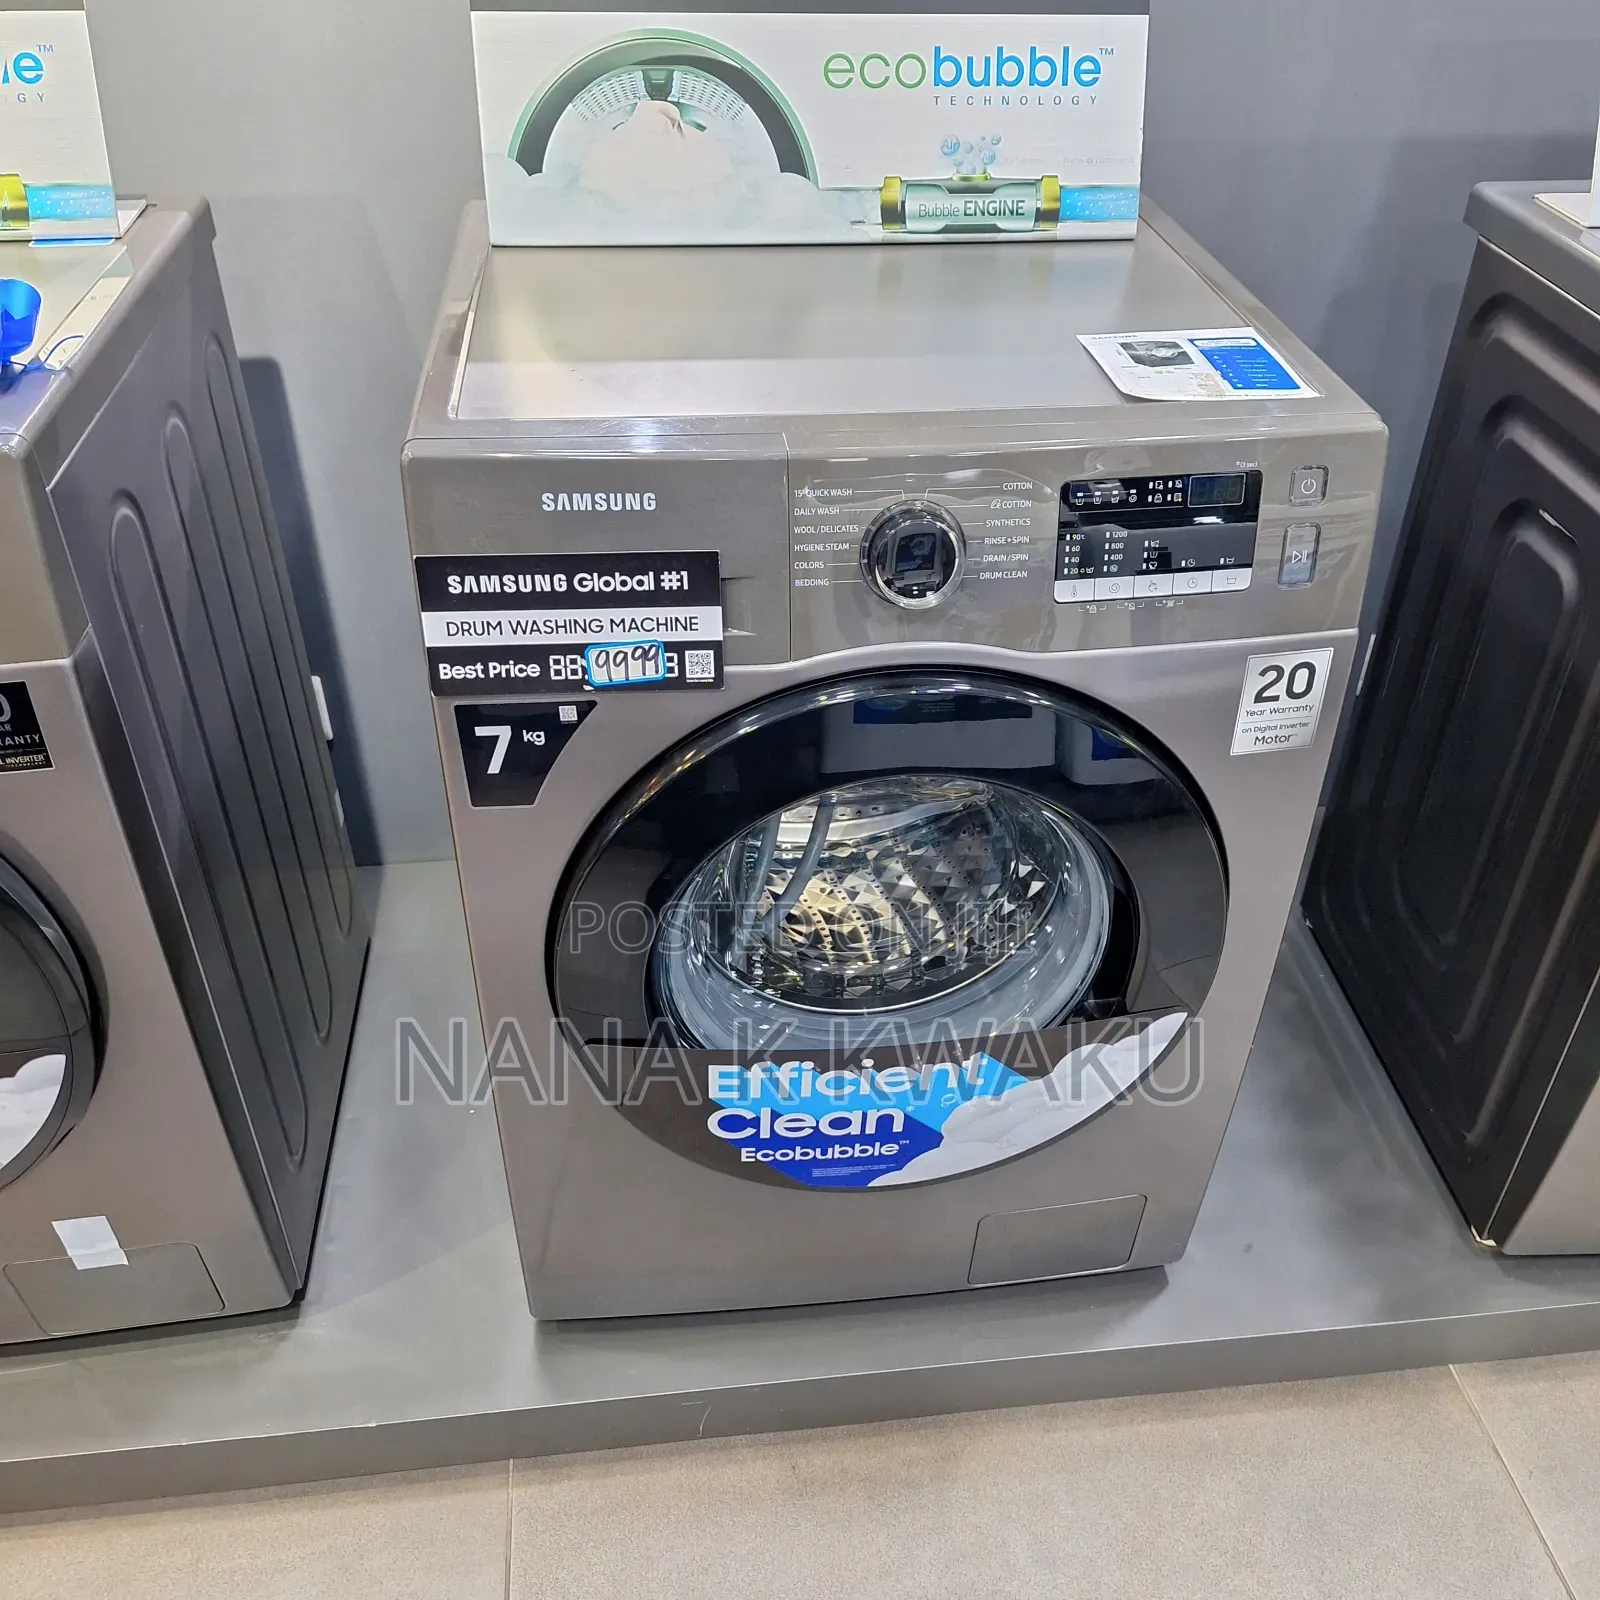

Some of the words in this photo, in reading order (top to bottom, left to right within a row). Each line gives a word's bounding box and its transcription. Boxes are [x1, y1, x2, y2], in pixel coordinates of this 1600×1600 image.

[933, 95, 1098, 106] TECHNOLOGY
[918, 203, 960, 218] Bubble
[963, 199, 1026, 217] ENGINE
[1002, 482, 1033, 491] COTTON
[805, 488, 830, 498] QUICK
[830, 488, 853, 497] WASH
[541, 492, 657, 512] SAMSUNG
[1002, 500, 1032, 509] COTTON
[794, 508, 817, 516] DAILY
[817, 507, 840, 516] WASH
[985, 518, 1031, 528] SYNTHETICS
[1112, 530, 1128, 538] 1200
[794, 543, 825, 552] HYGIENE
[825, 542, 850, 551] STEAM
[1111, 542, 1125, 550] 800
[1070, 556, 1080, 564] 40
[1110, 553, 1124, 561] 400
[794, 560, 825, 569] COLORS
[979, 571, 1002, 580] DRUM
[1002, 570, 1028, 579] CLEAN
[1069, 567, 1079, 575] 20
[447, 573, 567, 594] SAMSUNG
[572, 571, 655, 592] Global
[660, 570, 689, 590] #1
[794, 577, 830, 587] BEDDING
[445, 620, 503, 637] DRUM
[508, 618, 604, 635] WASHING
[609, 615, 699, 633] MACHINE
[594, 643, 660, 682] 9999
[438, 662, 485, 680] Best
[489, 659, 541, 679] Price
[1253, 661, 1317, 704] 20
[1245, 709, 1267, 717] Year
[1269, 704, 1315, 716] Warranty
[1253, 724, 1278, 733] Digital
[1279, 721, 1311, 730] Inverter
[474, 725, 511, 774] 7
[523, 730, 545, 745] kg
[708, 1054, 986, 1098] Efficient
